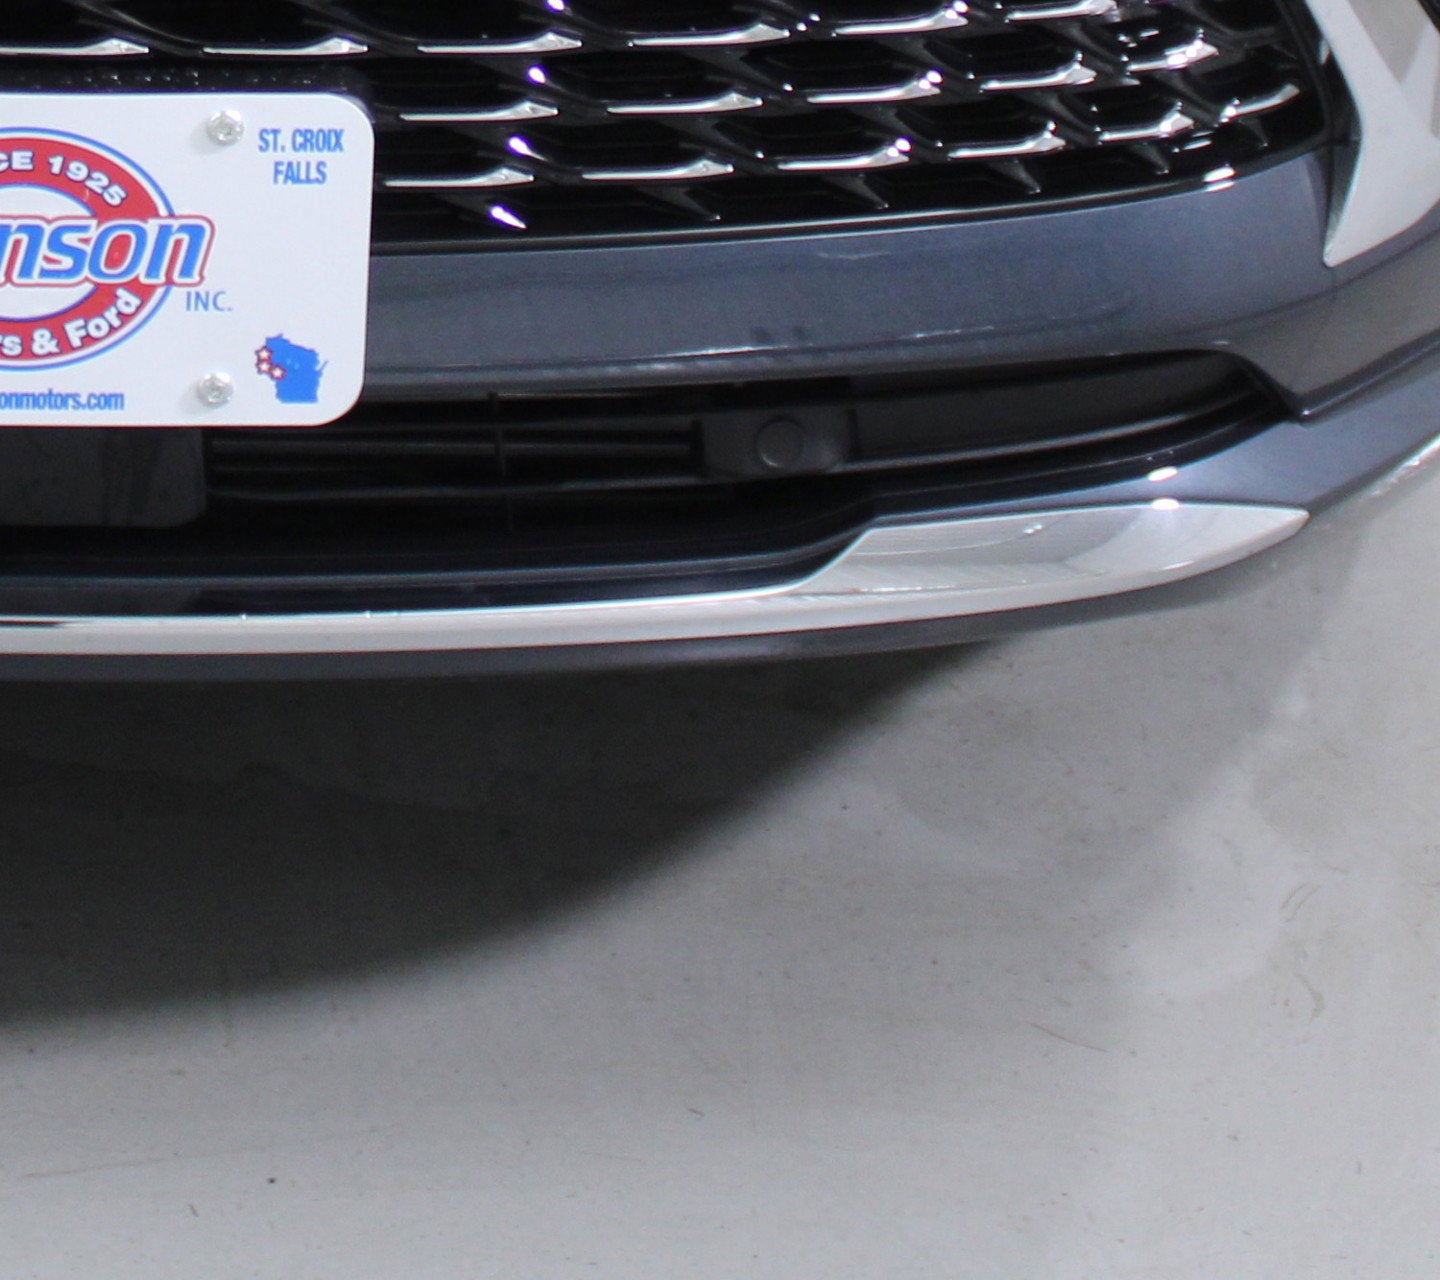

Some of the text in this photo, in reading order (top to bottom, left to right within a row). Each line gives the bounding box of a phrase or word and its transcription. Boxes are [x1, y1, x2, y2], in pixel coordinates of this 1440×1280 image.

[258, 128, 344, 152] ST. CROIX
[47, 152, 128, 208] 1925
[273, 160, 327, 185] FALLS
[185, 291, 233, 313] INC.
[31, 327, 61, 358] &
[64, 287, 144, 349] Ford
